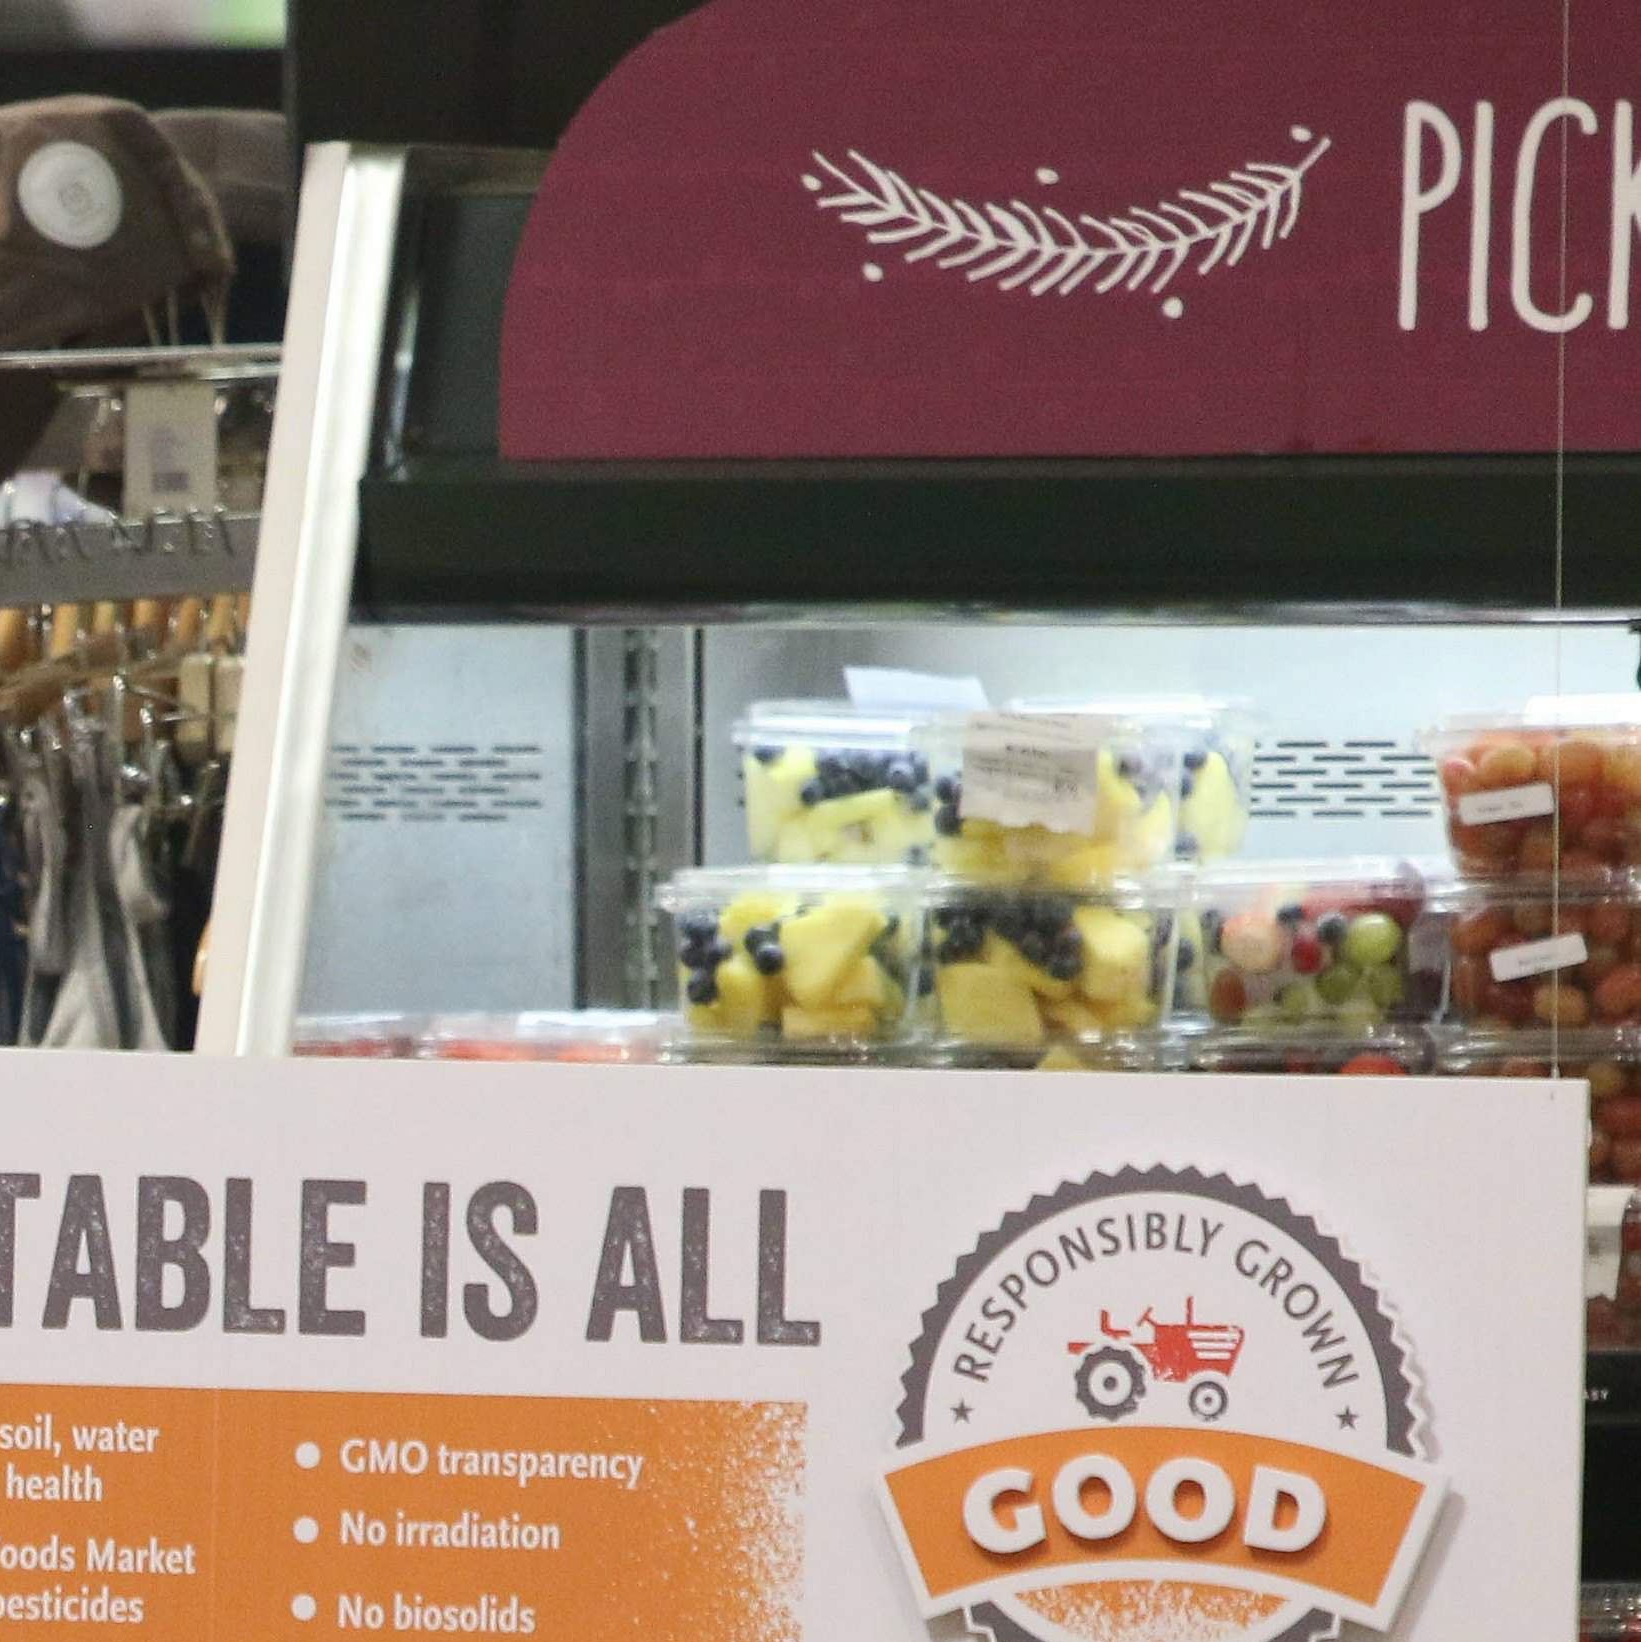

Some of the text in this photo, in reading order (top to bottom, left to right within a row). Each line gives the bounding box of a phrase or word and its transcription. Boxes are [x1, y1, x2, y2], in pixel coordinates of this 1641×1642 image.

[420, 1181, 538, 1341] IS
[585, 1186, 822, 1346] ALL
[954, 1212, 1359, 1389] RESPONSIBLY GROWN
[71, 1420, 160, 1453] water
[6, 1462, 104, 1502] health
[339, 1438, 644, 1490] GMO transparency
[963, 1454, 1328, 1555] GOOD
[340, 1509, 561, 1550] No irradiation
[87, 1536, 197, 1576] Market
[337, 1591, 537, 1634] No biosolids
